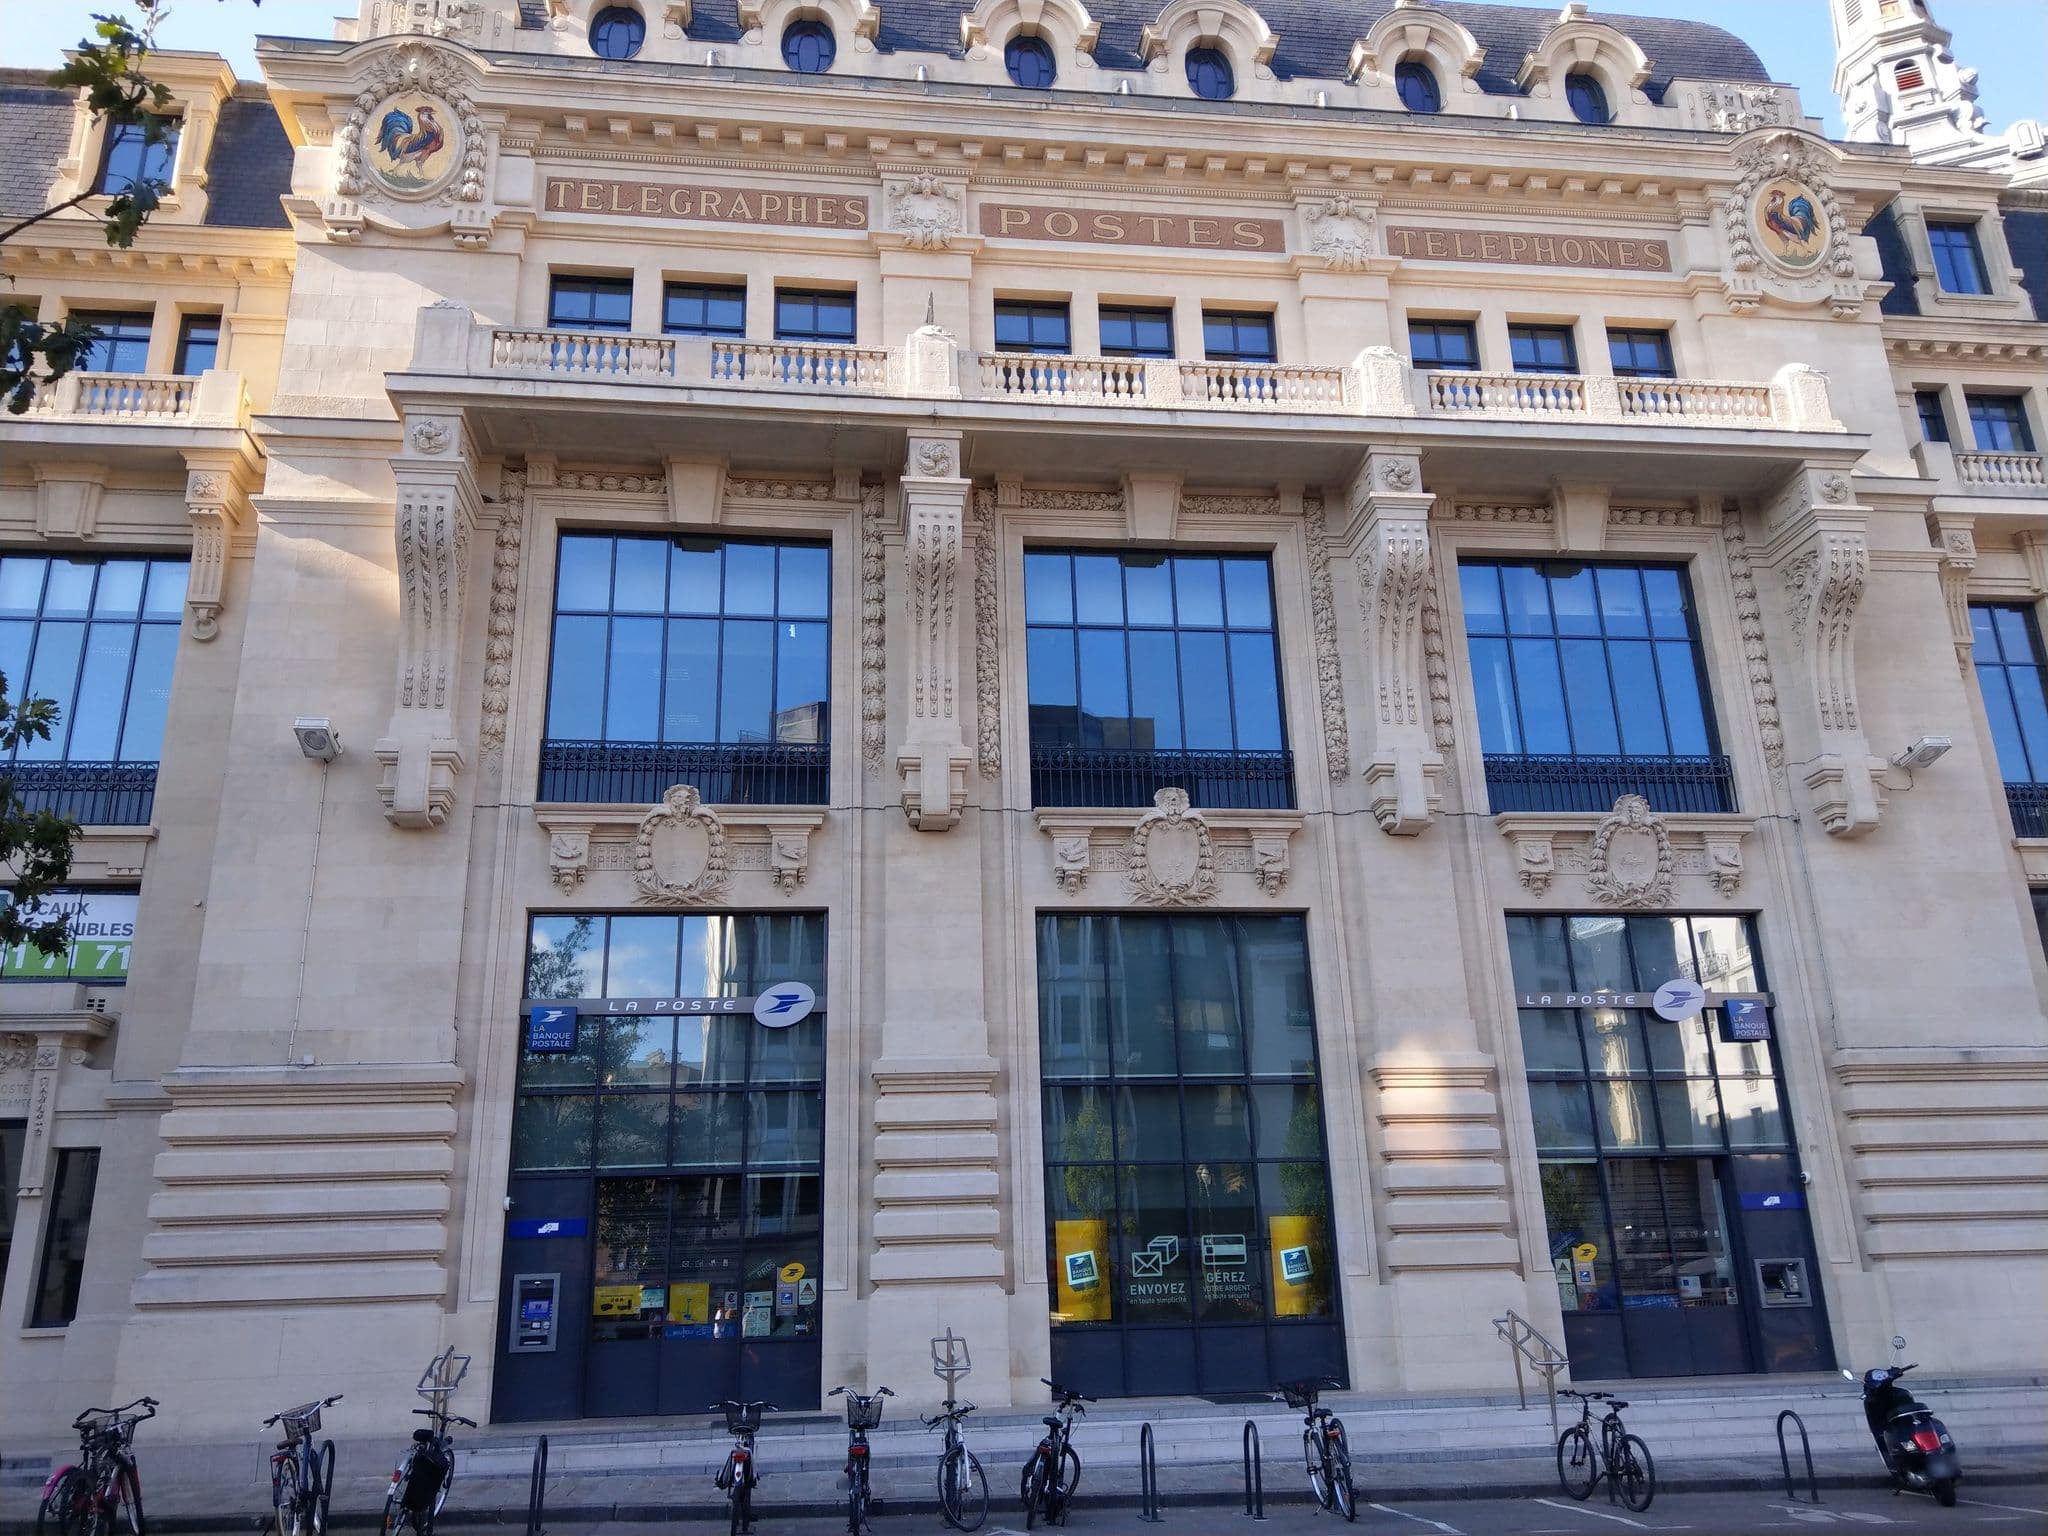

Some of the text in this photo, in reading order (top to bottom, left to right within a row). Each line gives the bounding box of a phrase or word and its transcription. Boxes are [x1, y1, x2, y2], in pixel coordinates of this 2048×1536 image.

[997, 207, 1266, 248] POSTES
[1393, 229, 1665, 269] TELEPHONES
[16, 902, 89, 916] OCAUX
[96, 944, 131, 970] 71
[608, 1000, 737, 1011] LA POSTE
[1526, 995, 1636, 1005] LA POSTE
[533, 1024, 545, 1032] LA
[1735, 1029, 1769, 1037] POSTALE
[532, 1031, 572, 1041] BANQUE
[531, 1039, 571, 1048] POSTALE
[1206, 1269, 1246, 1283] GÉREZ
[1129, 1282, 1185, 1296] ENVOYEZ
